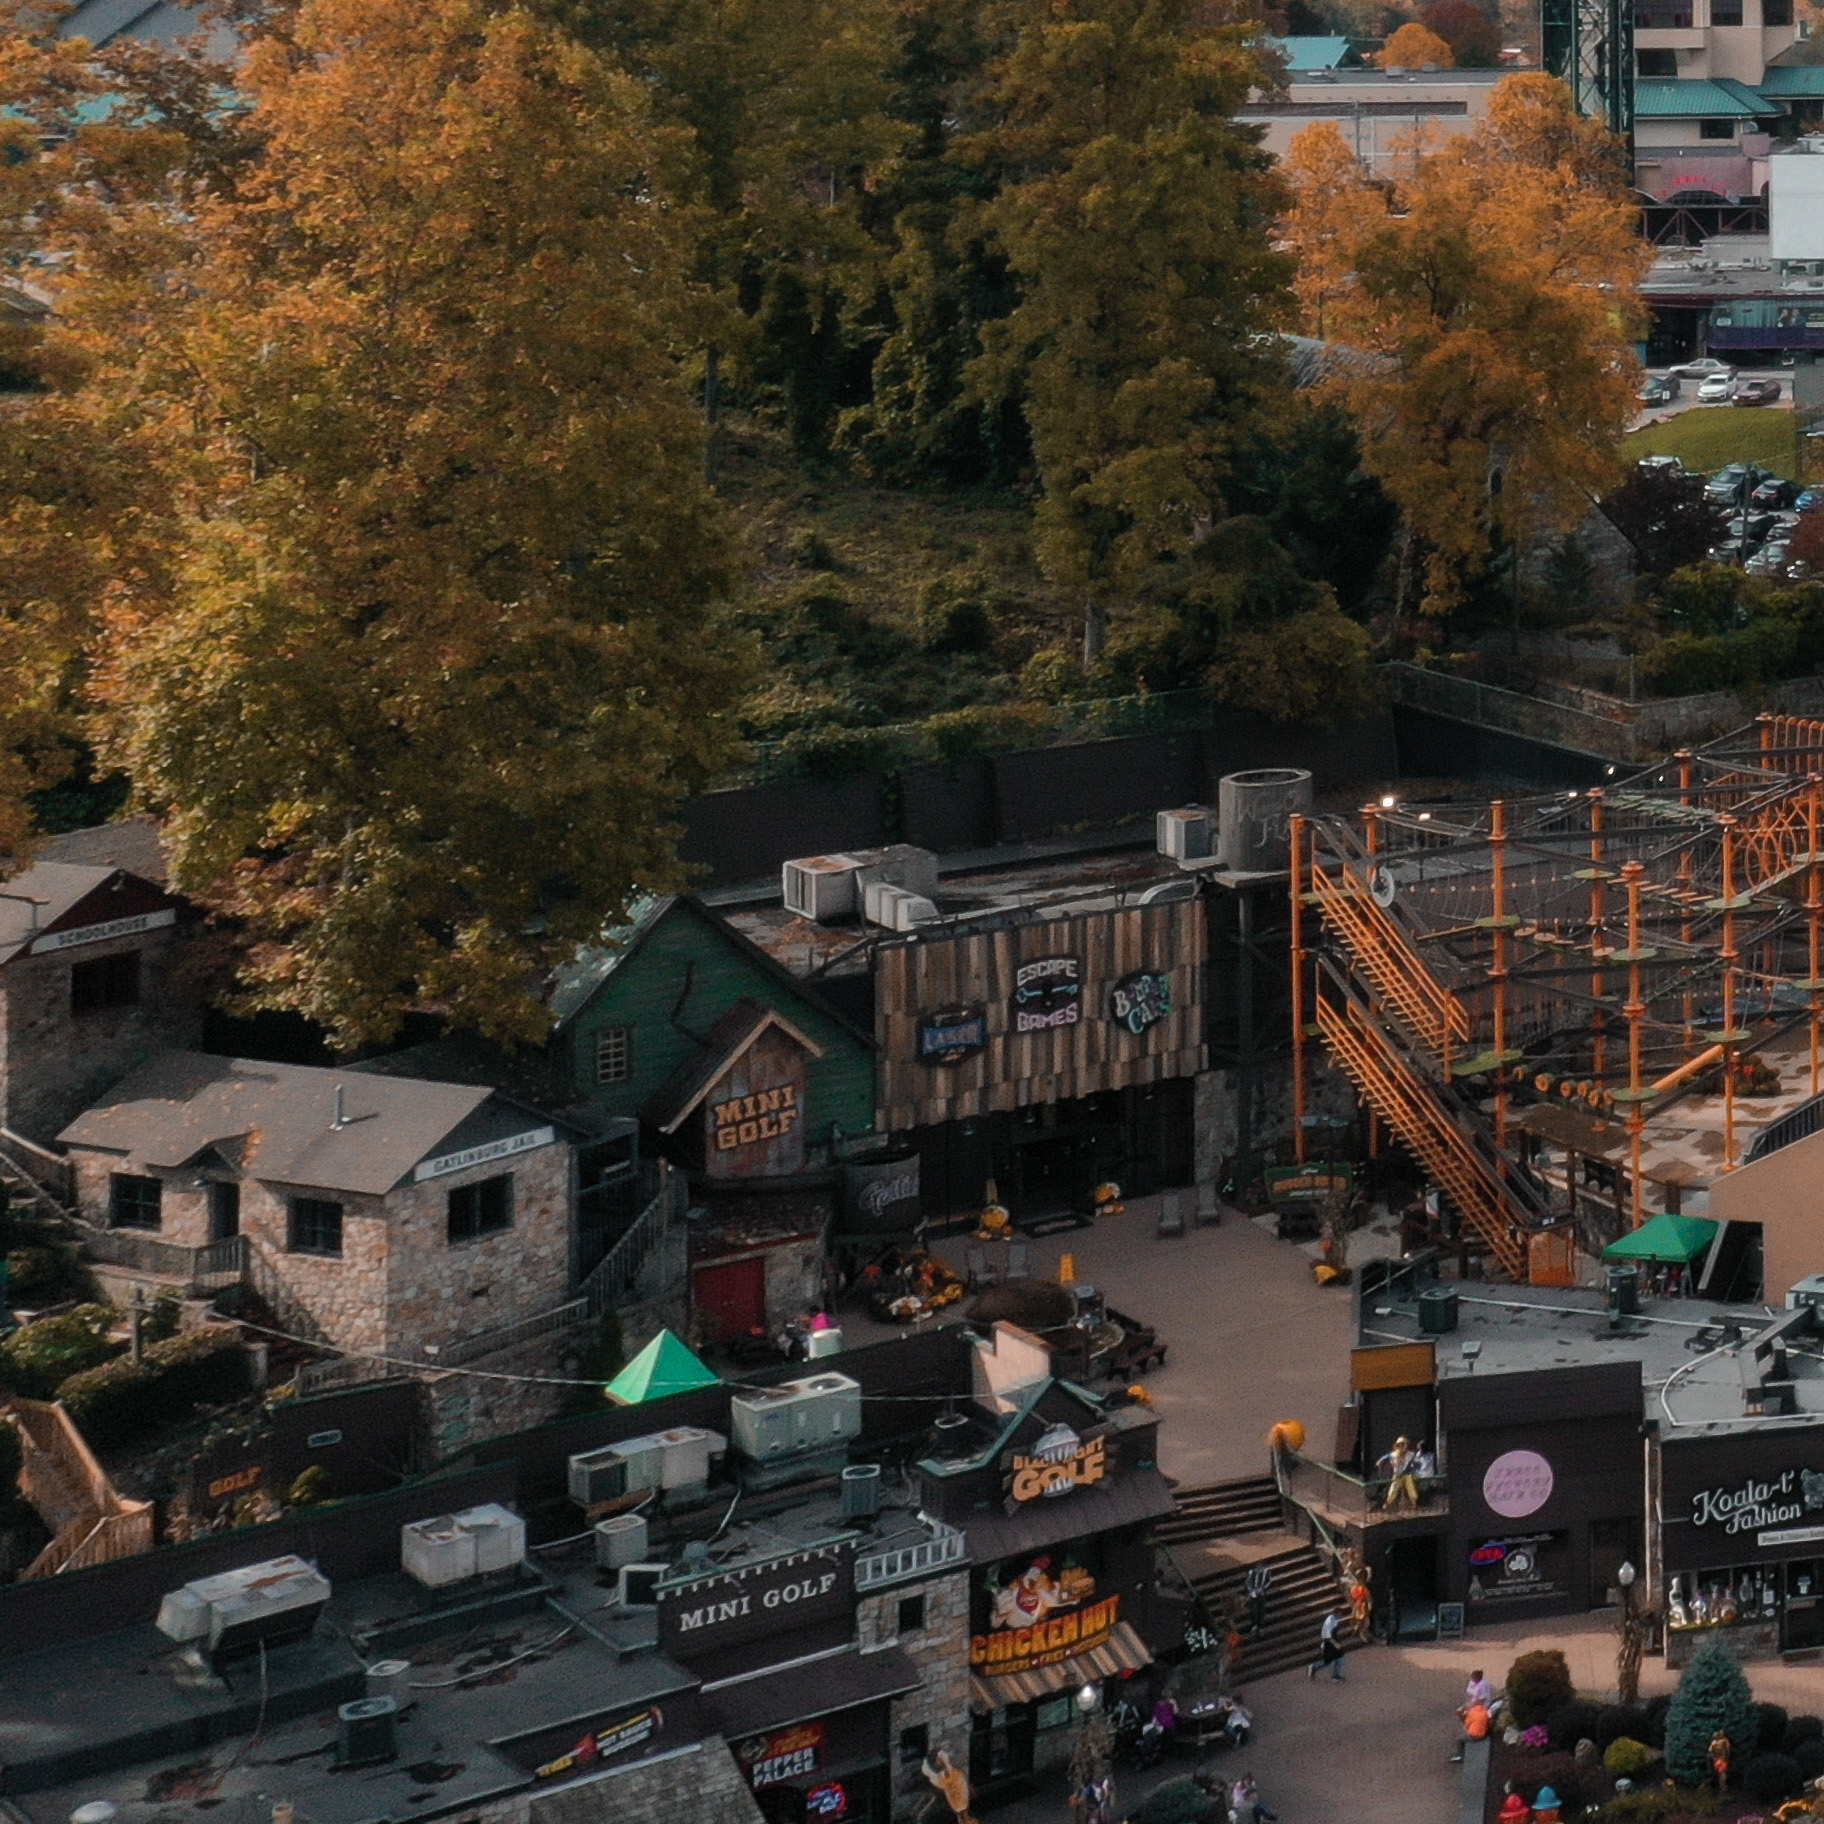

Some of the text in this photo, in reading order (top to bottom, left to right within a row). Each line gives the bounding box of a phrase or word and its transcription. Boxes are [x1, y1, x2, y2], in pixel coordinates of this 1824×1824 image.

[59, 916, 148, 946] SCHOOLHOUSE
[1016, 959, 1078, 987] ESCAPE
[1016, 1002, 1078, 1032] GAMES
[714, 1085, 795, 1126] MINI
[716, 1109, 797, 1150] GOLF
[433, 1134, 534, 1173] GATLINBURG JAIL
[208, 1465, 264, 1498] GOLF
[1012, 1452, 1106, 1502] GOLF
[1725, 1503, 1802, 1534] Fashion
[679, 1572, 837, 1632] MINI GOLF
[970, 1612, 1078, 1664] CHICKEN
[1081, 1594, 1121, 1639] HUT
[752, 1746, 815, 1776] PEPPER
[752, 1759, 815, 1788] PALACE
